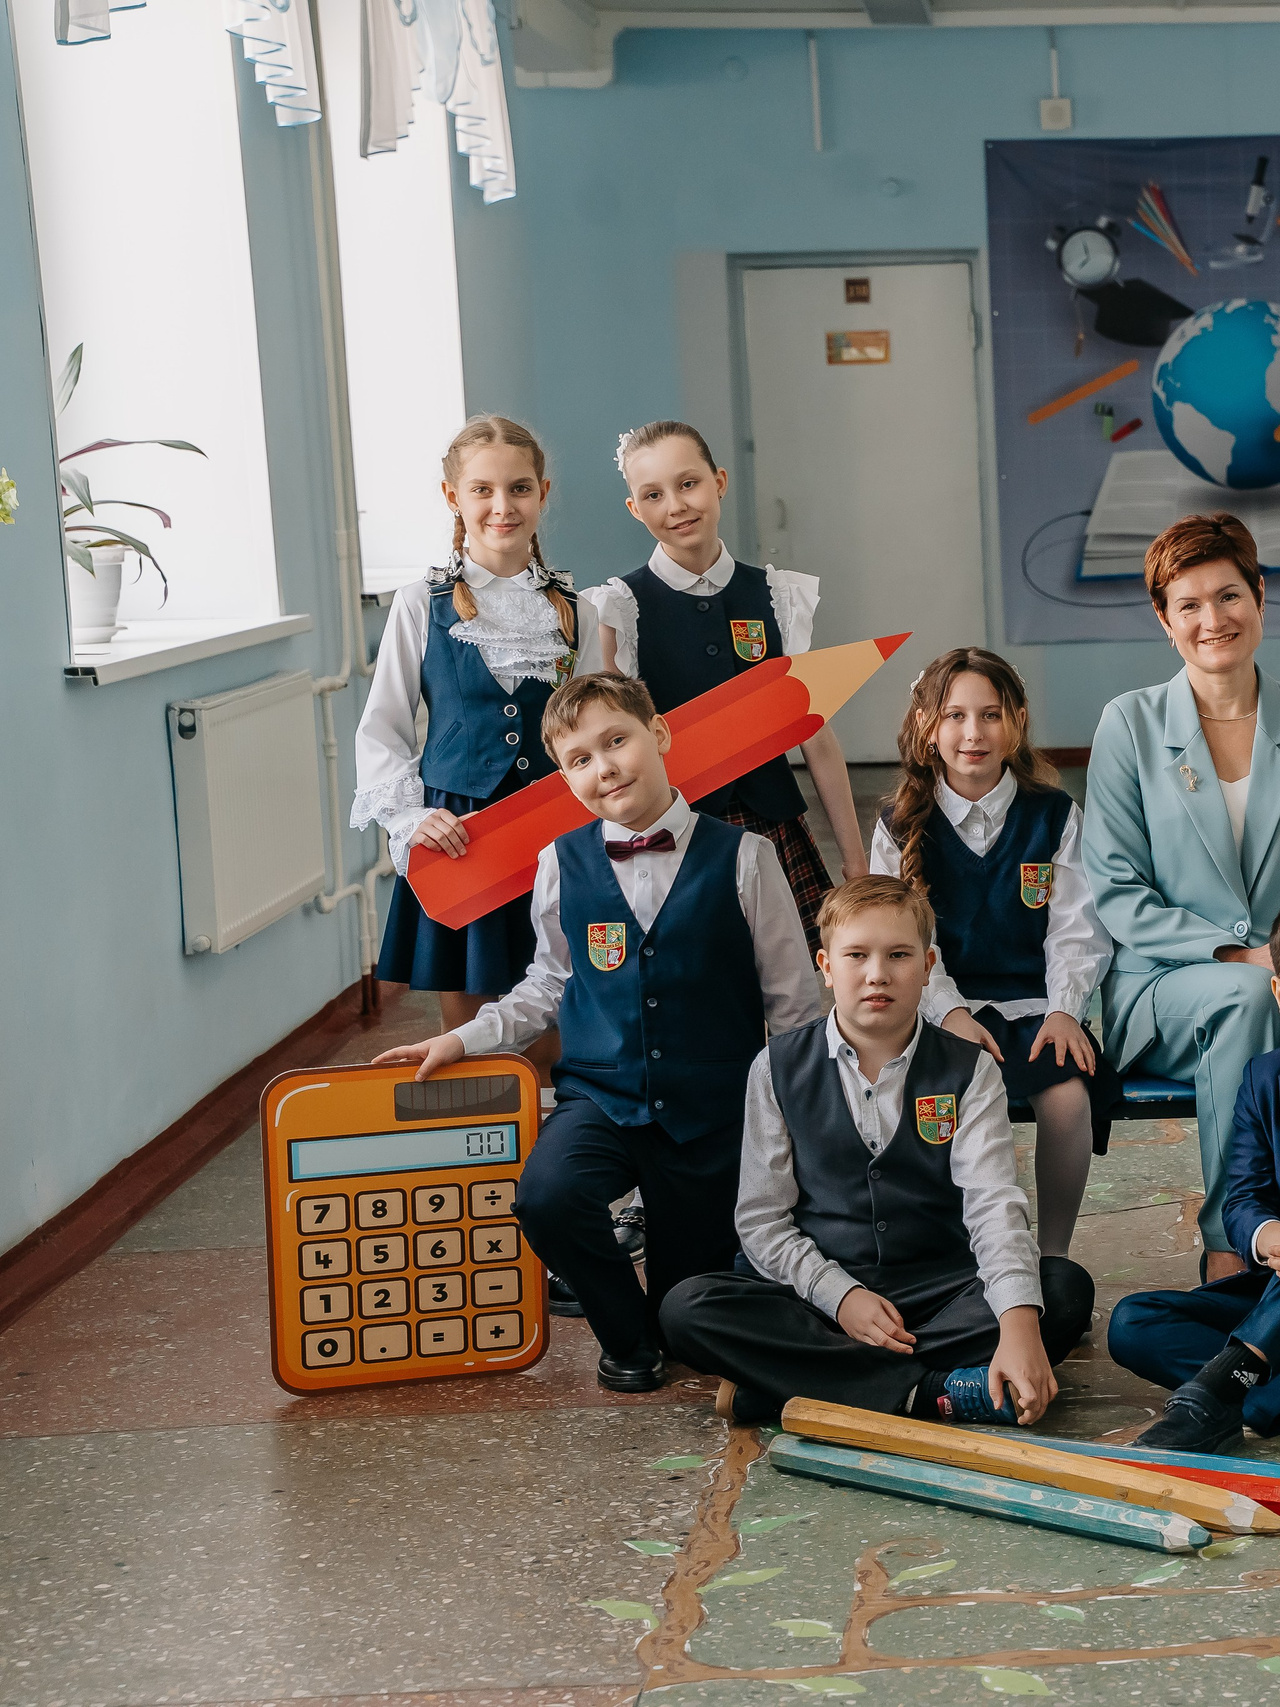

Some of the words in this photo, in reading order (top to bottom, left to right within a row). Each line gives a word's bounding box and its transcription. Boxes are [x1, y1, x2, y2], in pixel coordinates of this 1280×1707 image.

[466, 1131, 505, 1157] 00
[314, 1204, 330, 1224] 7
[372, 1199, 387, 1218] 8
[429, 1194, 445, 1213] 9
[315, 1251, 332, 1269] 4
[374, 1244, 389, 1263] 5
[430, 1240, 446, 1258] 6
[320, 1294, 331, 1313] 1
[374, 1289, 391, 1308] 2
[432, 1283, 448, 1302] 3
[318, 1338, 338, 1357] 0
